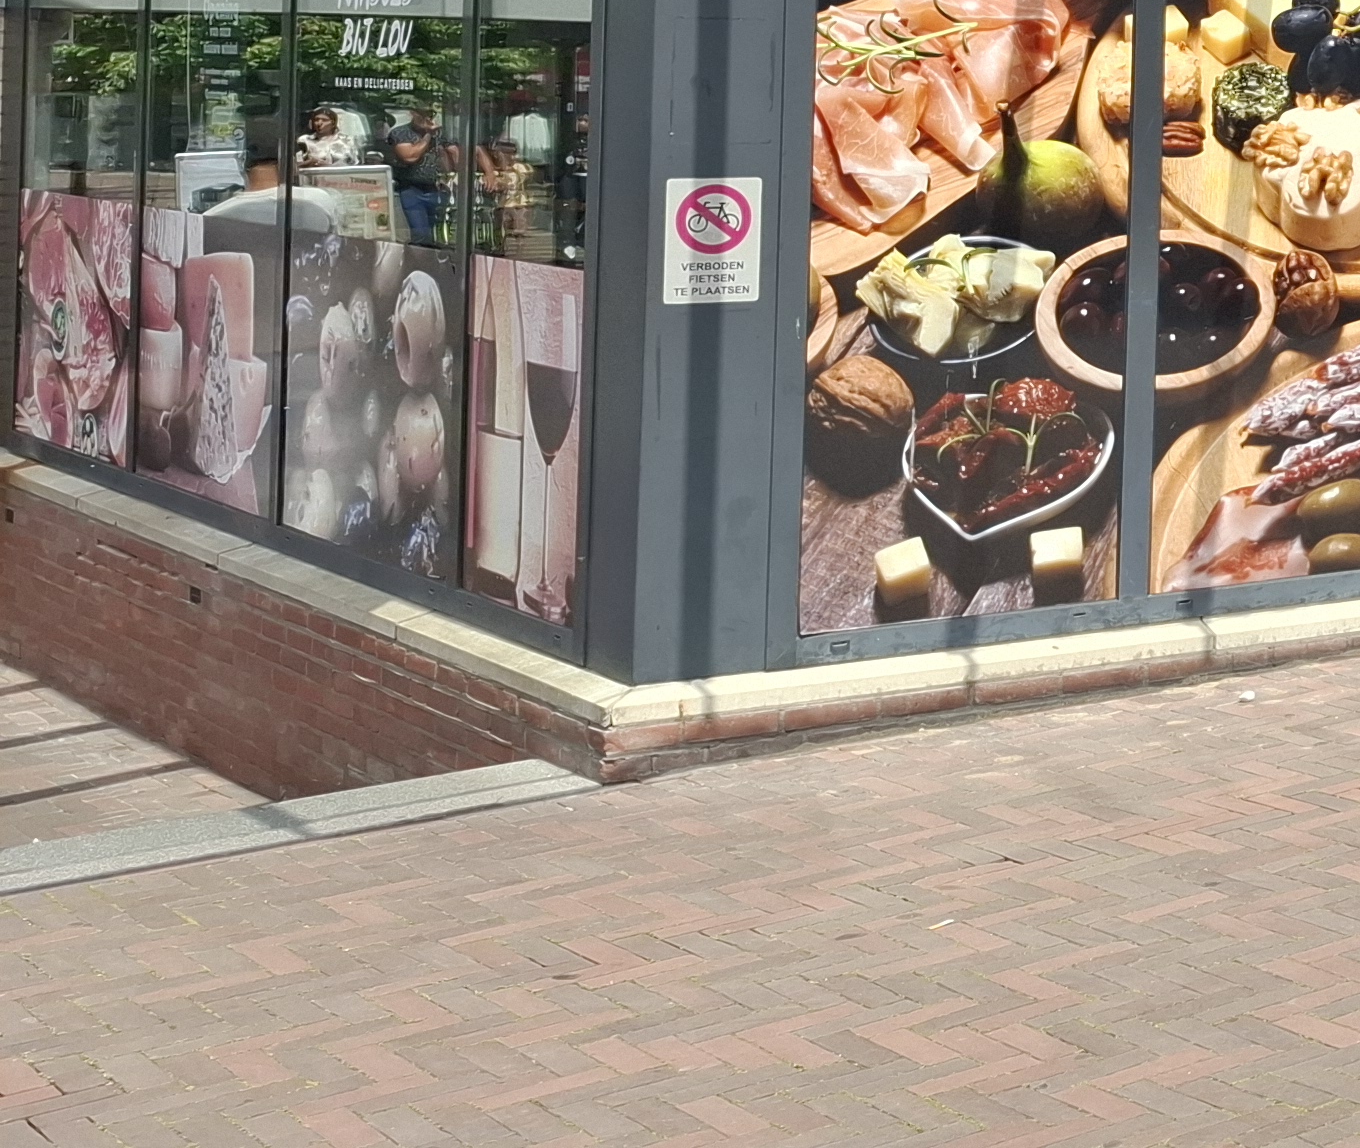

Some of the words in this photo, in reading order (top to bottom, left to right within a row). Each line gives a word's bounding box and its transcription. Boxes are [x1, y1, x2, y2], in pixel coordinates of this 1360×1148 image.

[338, 18, 374, 56] BIJ
[376, 20, 414, 57] LOU
[334, 76, 352, 88] KAAS
[681, 261, 744, 271] VERBODEN
[689, 273, 735, 284] FIETSEN
[673, 288, 688, 297] TE
[691, 285, 750, 296] PLAATSEN
